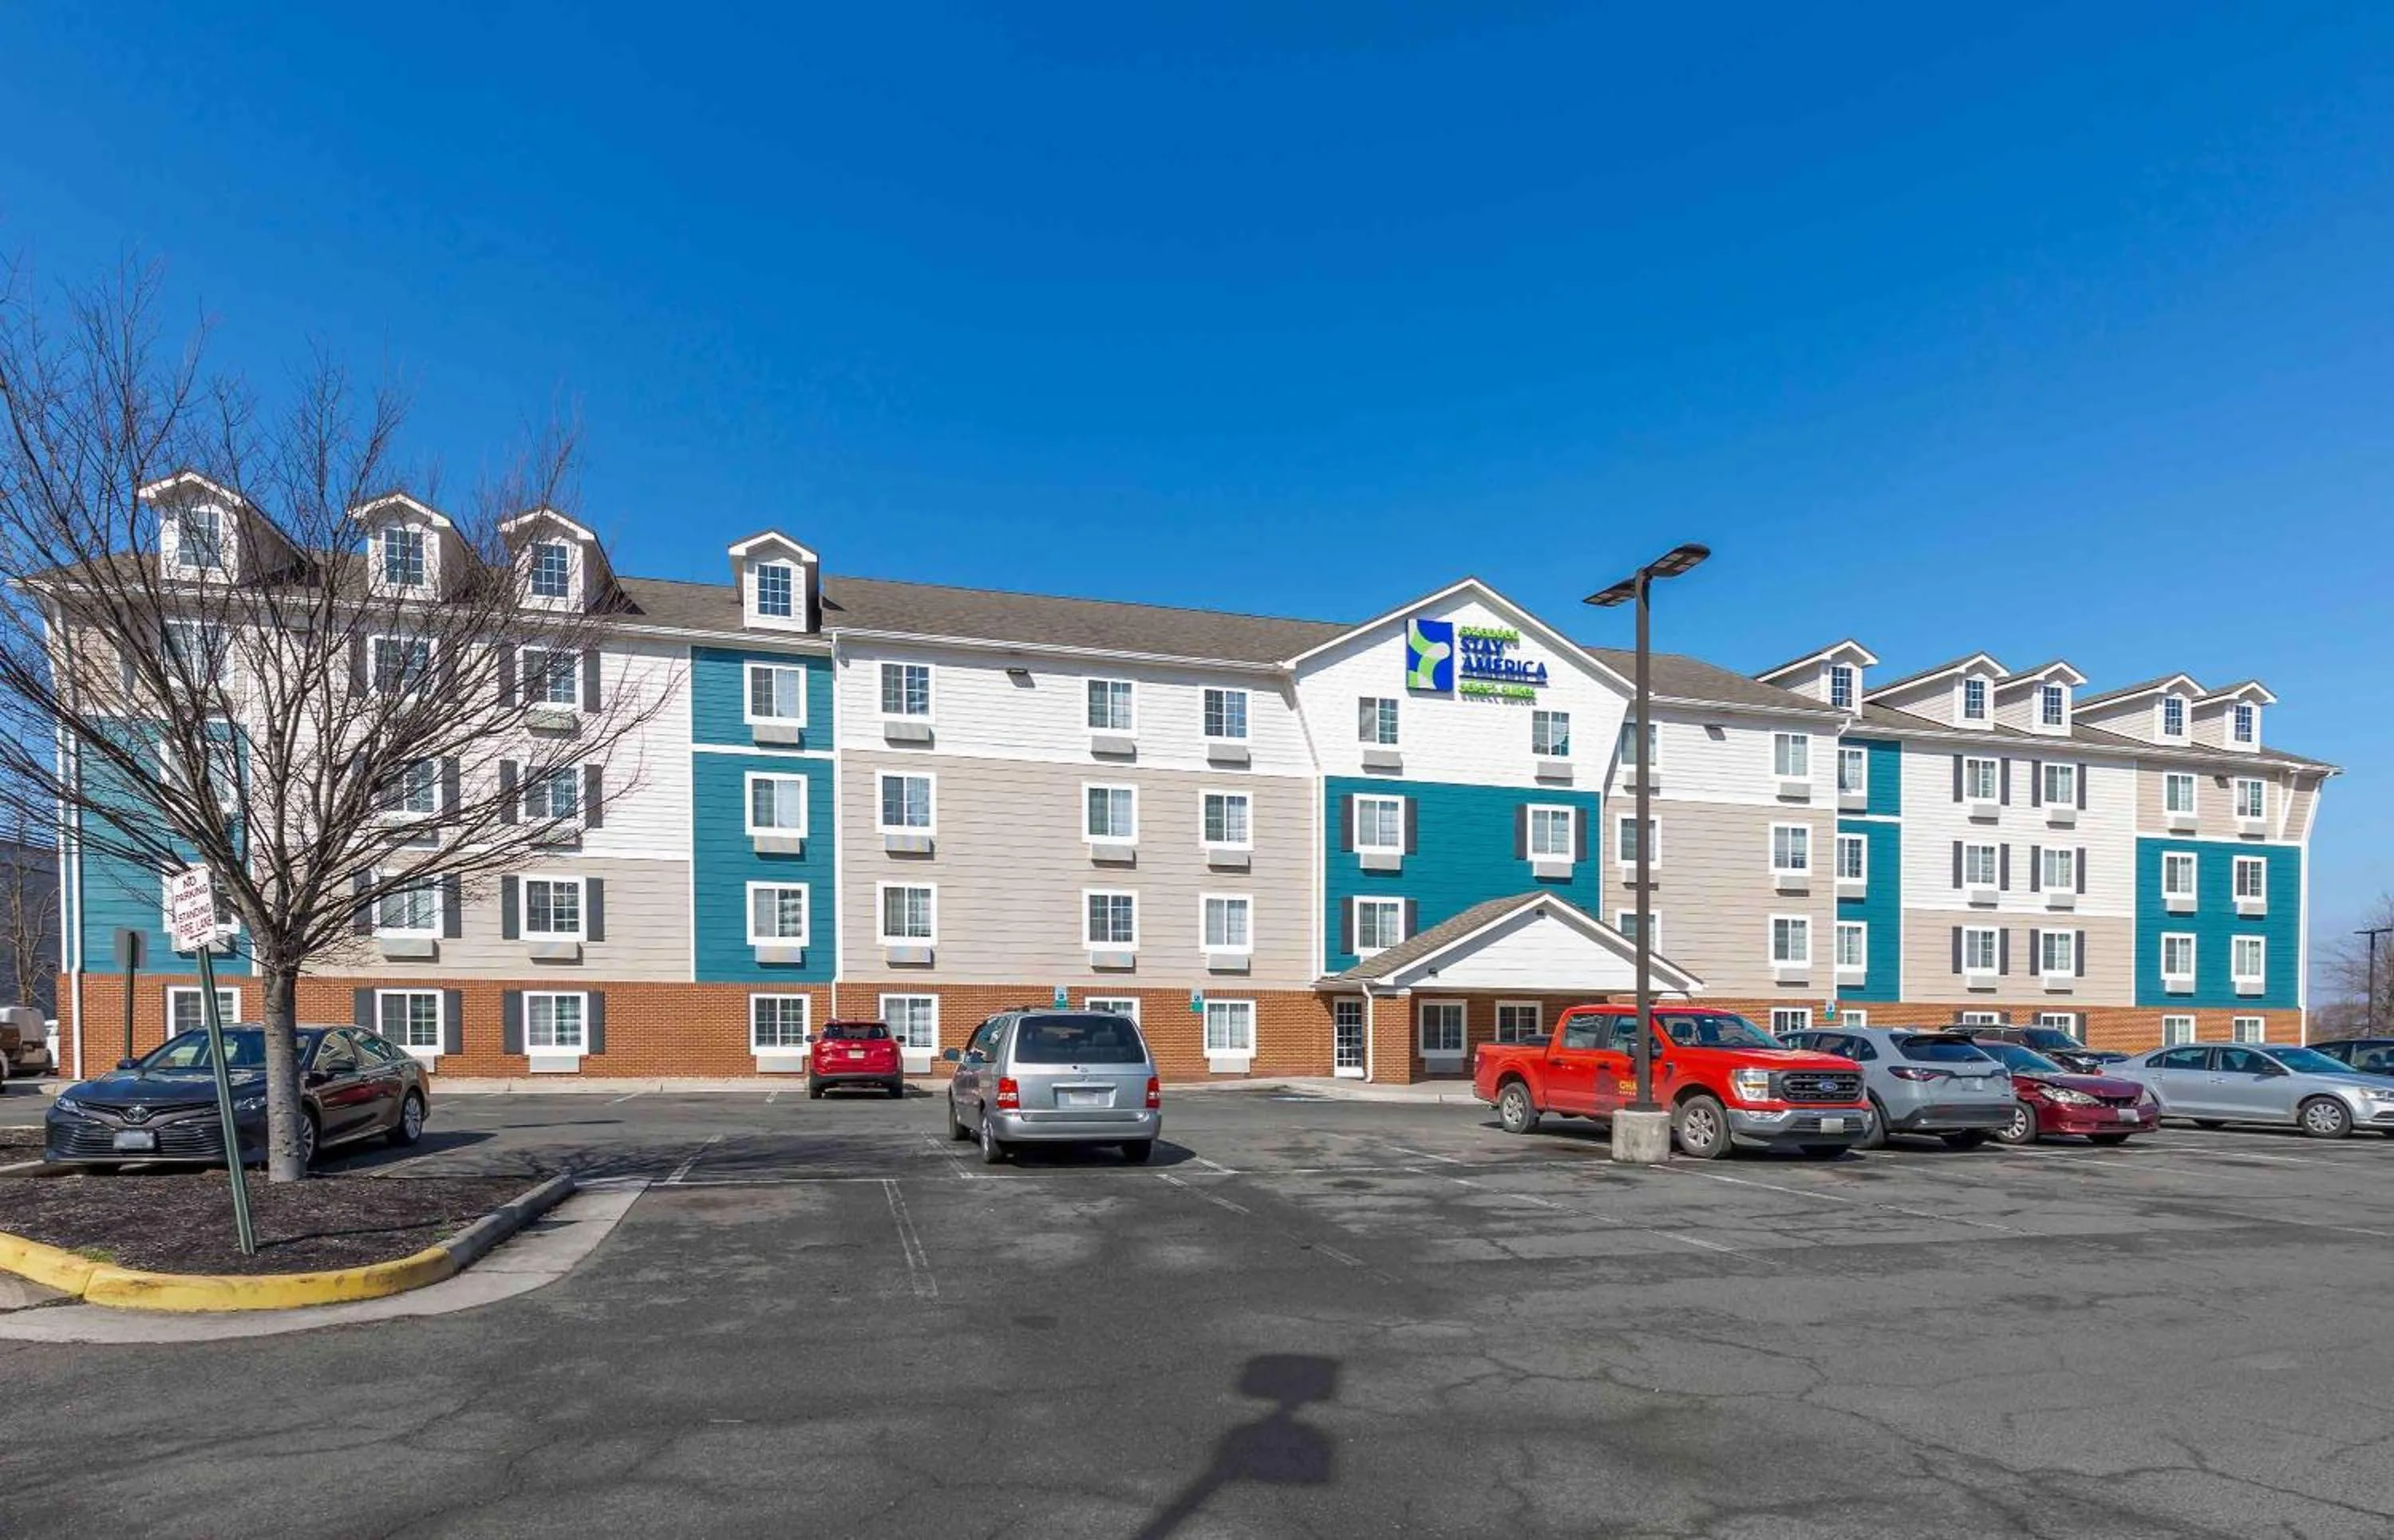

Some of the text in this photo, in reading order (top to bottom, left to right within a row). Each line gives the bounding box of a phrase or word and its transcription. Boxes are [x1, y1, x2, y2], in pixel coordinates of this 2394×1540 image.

[1460, 637, 1503, 657] STAY
[1461, 655, 1547, 679] AMERICA
[183, 875, 197, 888] NO
[175, 883, 208, 903] PARKING
[178, 903, 211, 923] STANDING
[180, 914, 213, 936] FIRE LANE
